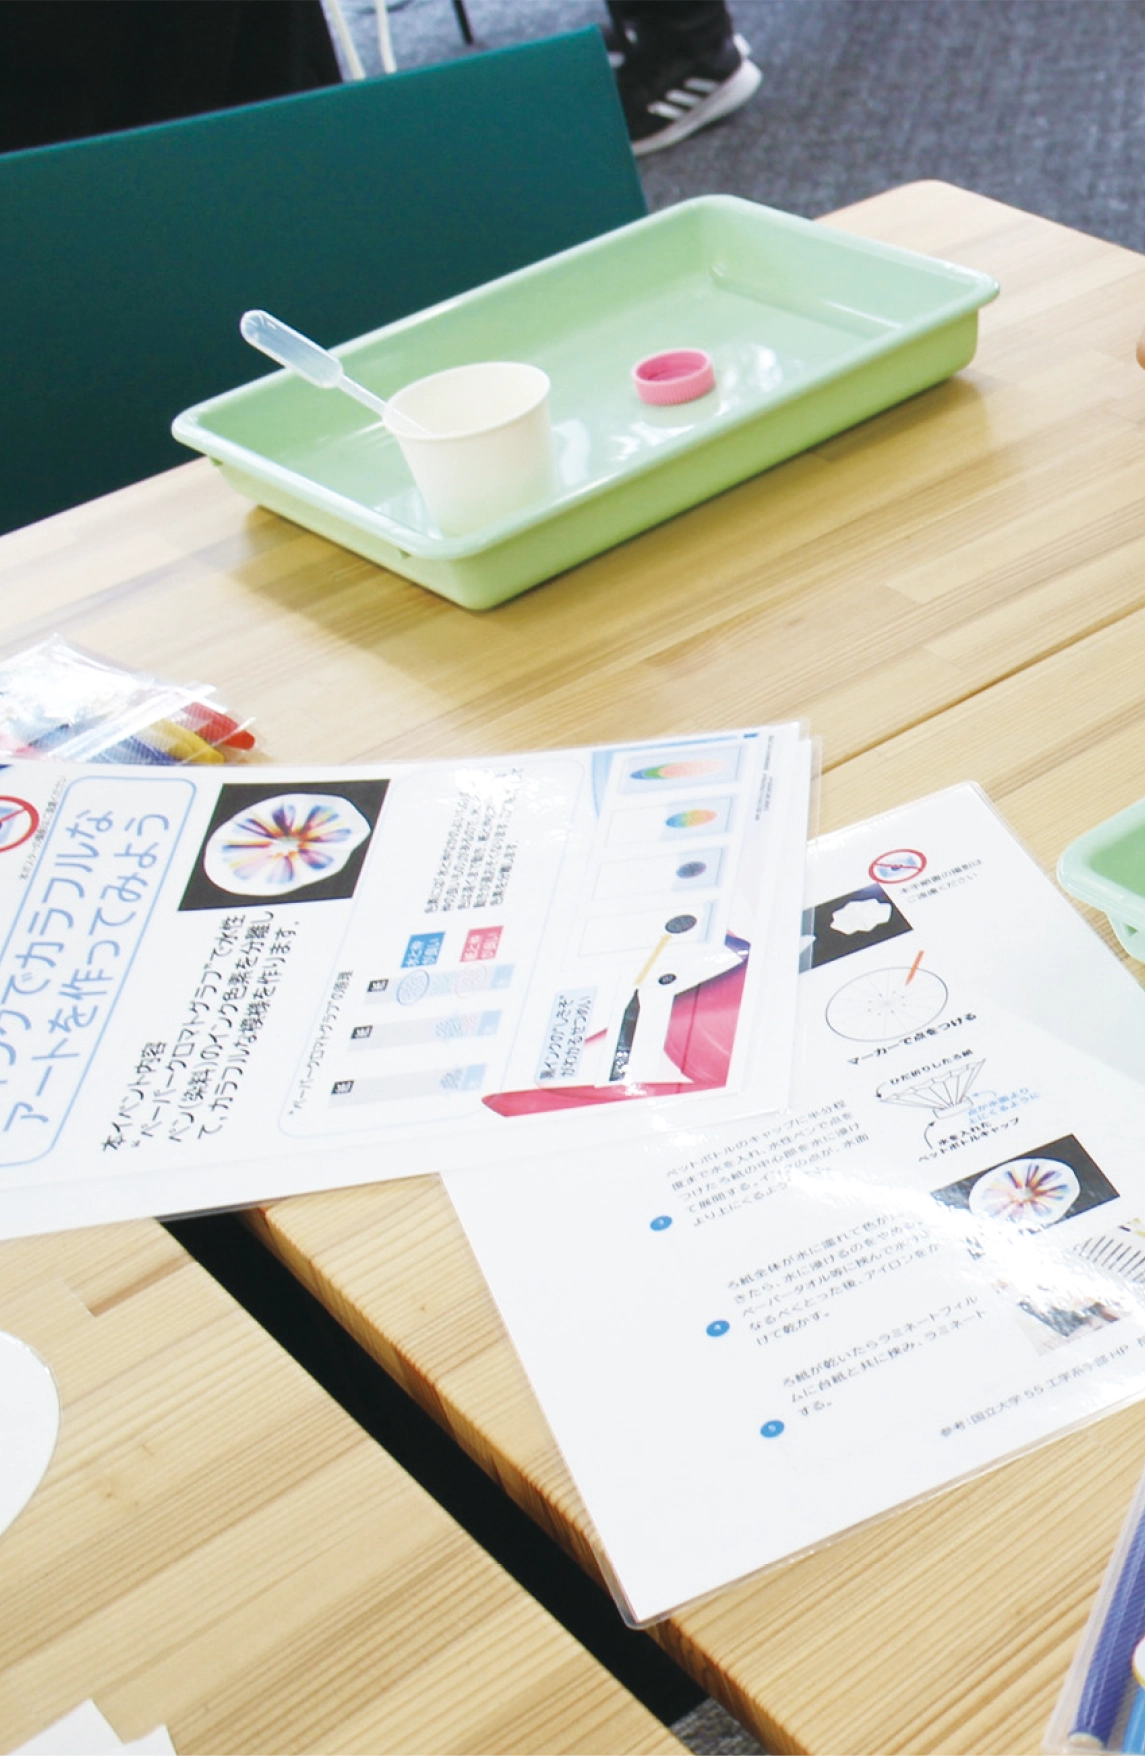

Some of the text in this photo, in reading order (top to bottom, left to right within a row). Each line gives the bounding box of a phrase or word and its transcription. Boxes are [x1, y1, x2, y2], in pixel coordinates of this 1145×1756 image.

[3, 814, 169, 1132] アートを作ってみよう
[848, 1011, 977, 1065] マーカーで点をつける
[102, 1042, 167, 1151] 本イベント内容
[919, 1116, 1019, 1162] ペットボトルキャップ
[939, 1121, 990, 1145] 水を入れた
[756, 1311, 830, 1346] けて乾かす。
[799, 1400, 832, 1416] する。
